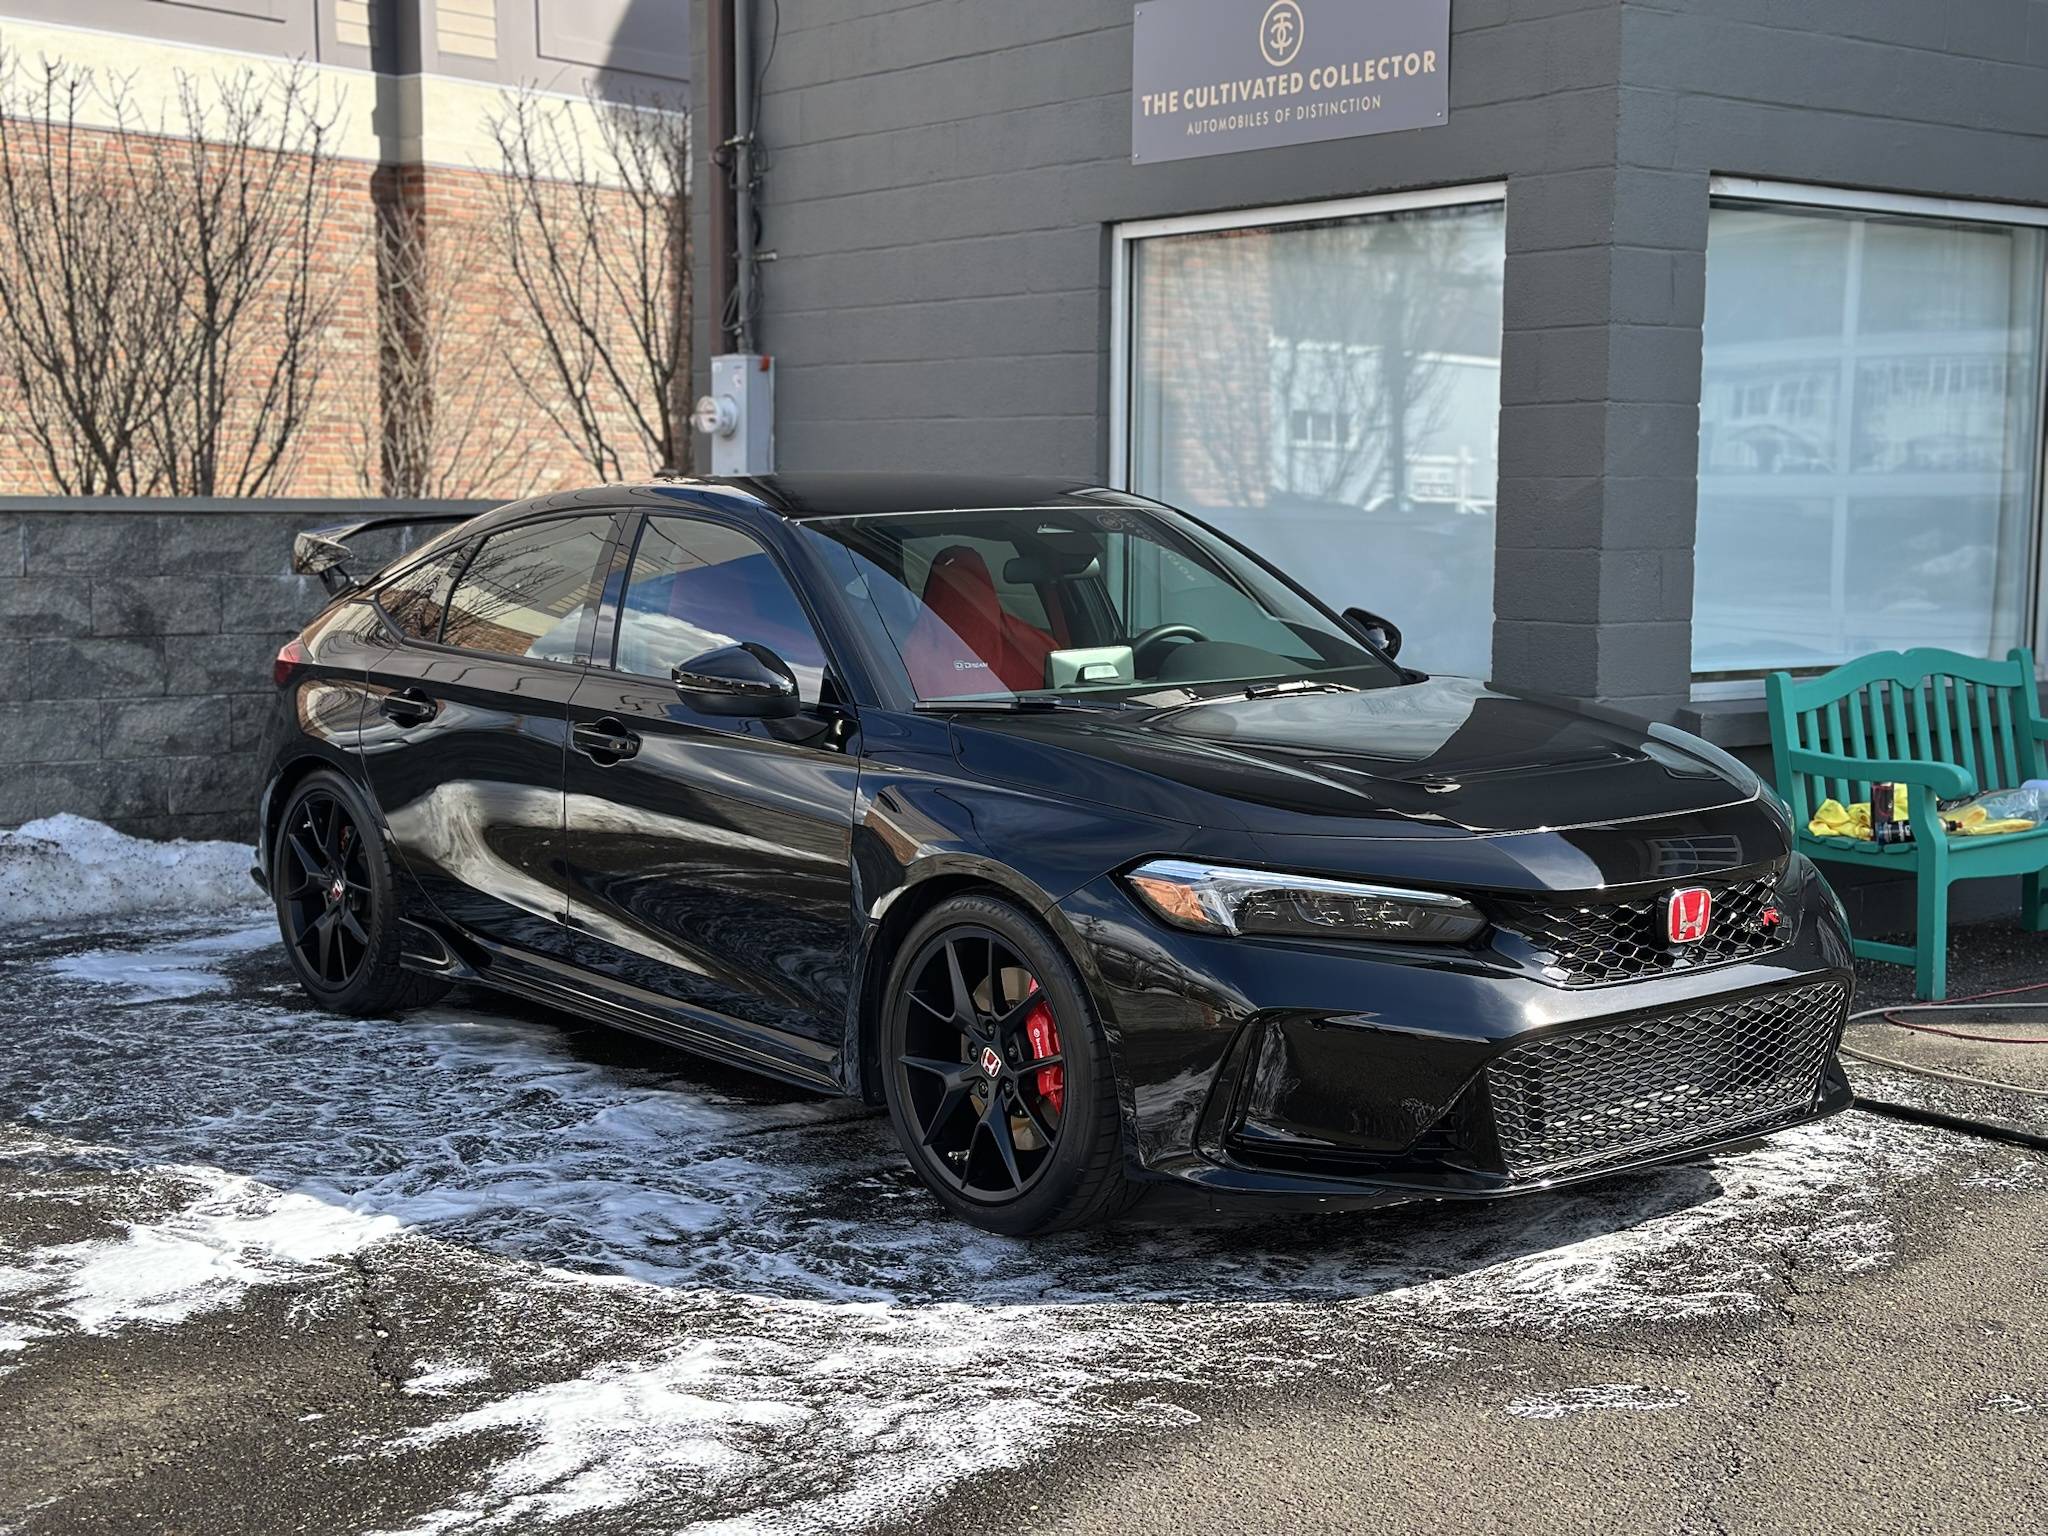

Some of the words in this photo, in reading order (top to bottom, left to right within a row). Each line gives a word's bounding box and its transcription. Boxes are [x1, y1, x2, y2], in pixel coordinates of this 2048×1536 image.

[1142, 92, 1179, 117] THE
[1183, 72, 1304, 110] CULTIVATED
[1309, 50, 1436, 91] COLLECTOR
[1186, 111, 1269, 135] AUTOMOBILES
[1275, 107, 1291, 123] OF
[1296, 95, 1382, 119] DISTINCTION
